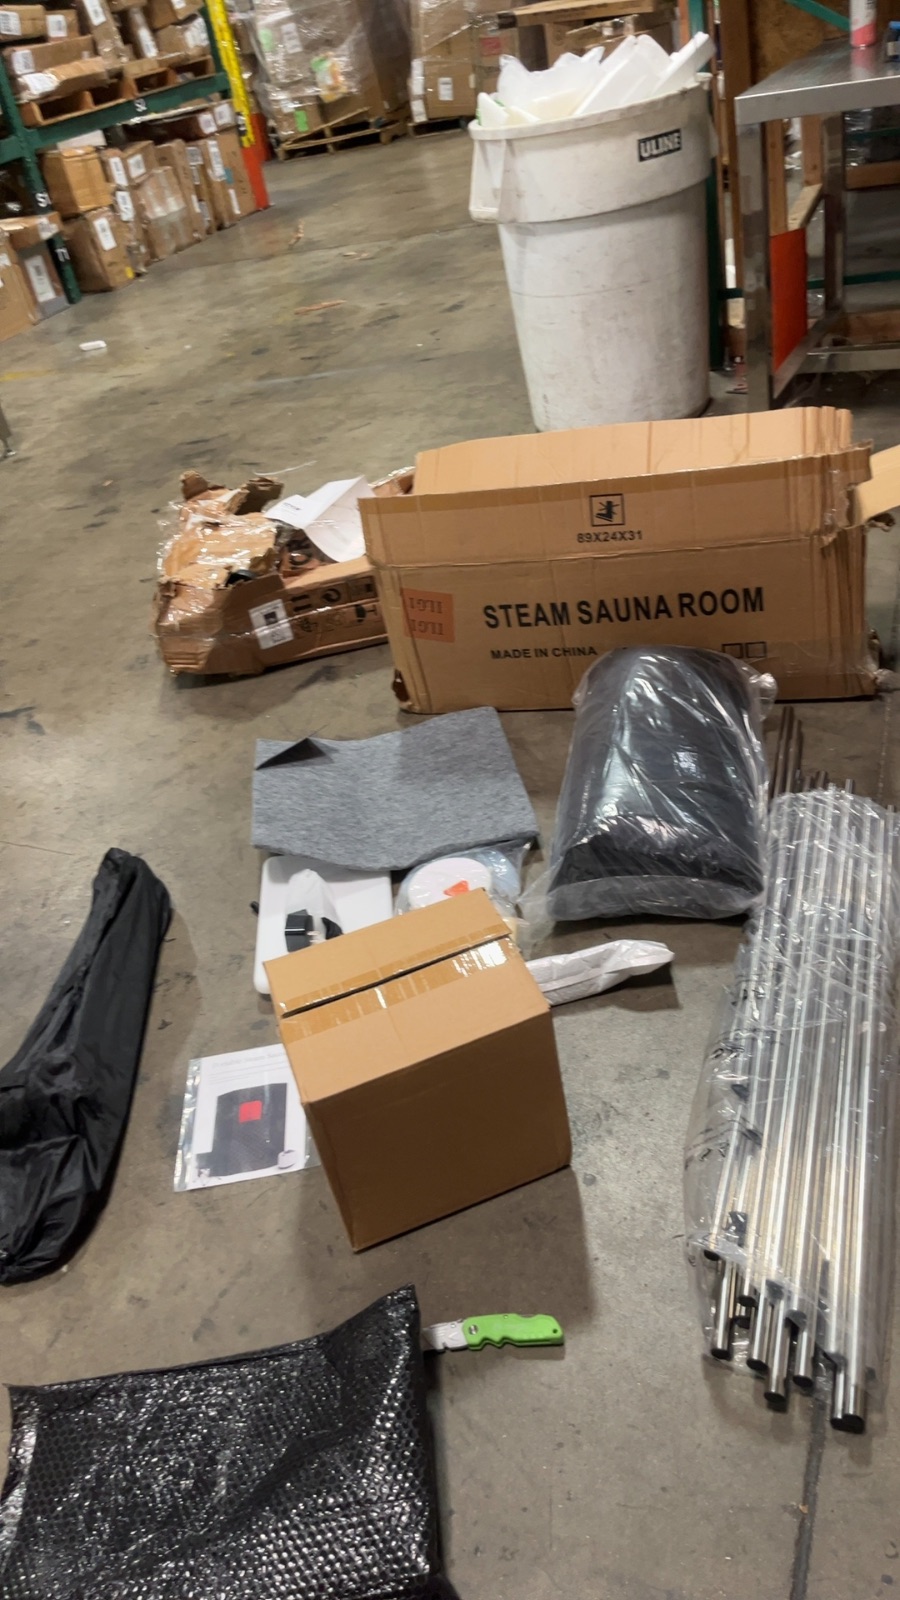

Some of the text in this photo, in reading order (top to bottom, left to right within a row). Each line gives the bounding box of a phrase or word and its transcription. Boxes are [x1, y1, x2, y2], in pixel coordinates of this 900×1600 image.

[639, 131, 681, 159] ULINE
[483, 586, 765, 629] STEAM SAUNA ROOM
[490, 646, 598, 659] MADE IN CHINA
